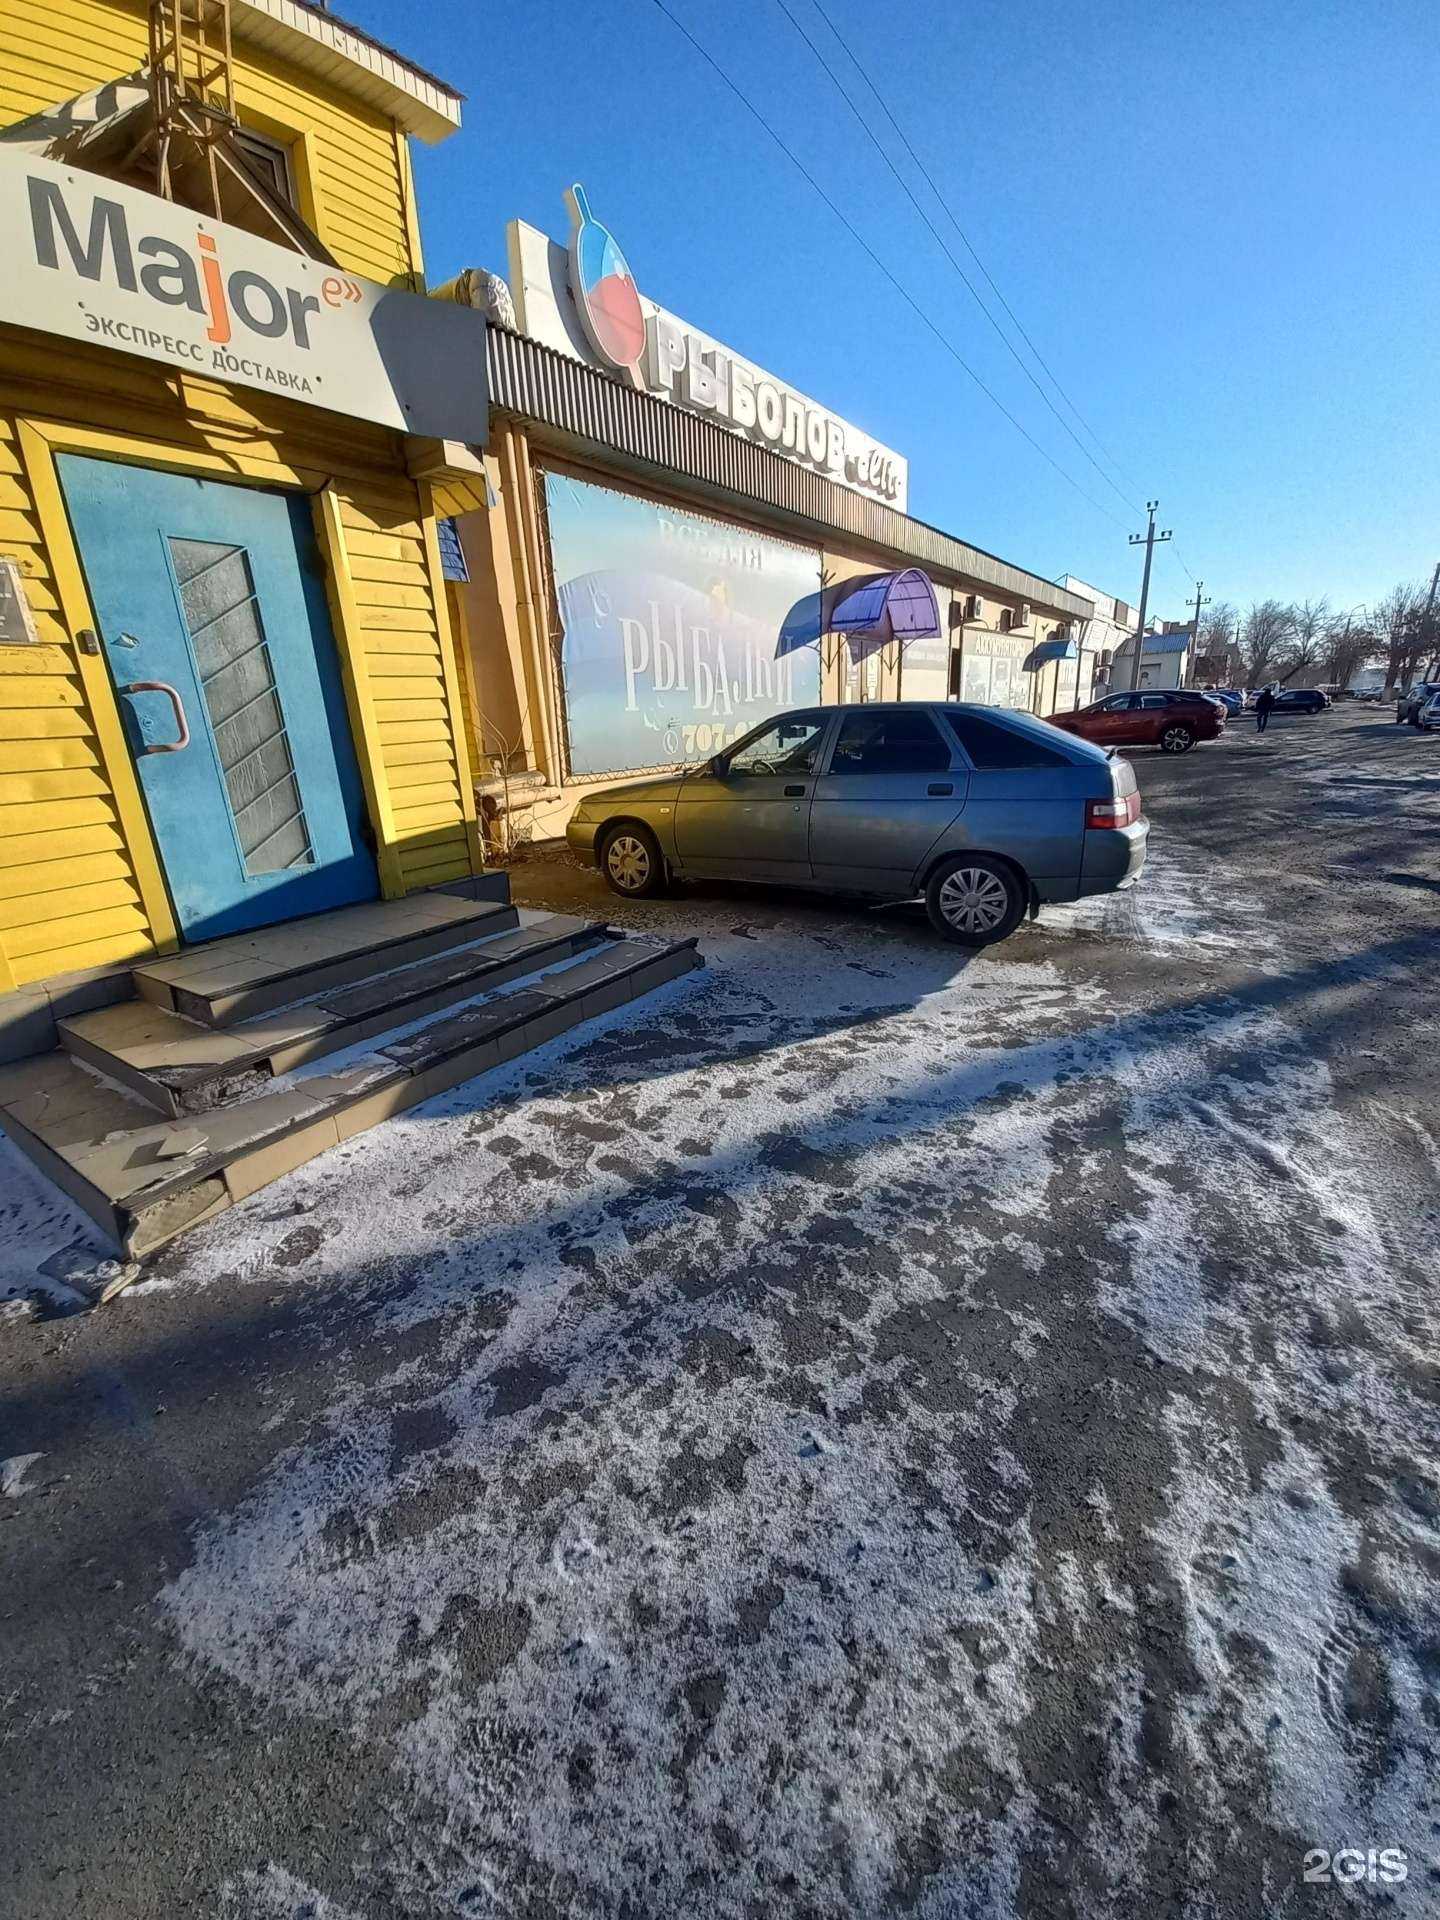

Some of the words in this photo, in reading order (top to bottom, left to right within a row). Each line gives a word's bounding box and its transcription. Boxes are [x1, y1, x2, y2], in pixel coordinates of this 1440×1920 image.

[27, 175, 321, 350] Major
[85, 313, 204, 362] ЭКСПРЕСС
[212, 349, 313, 394] ДОСТАВКА
